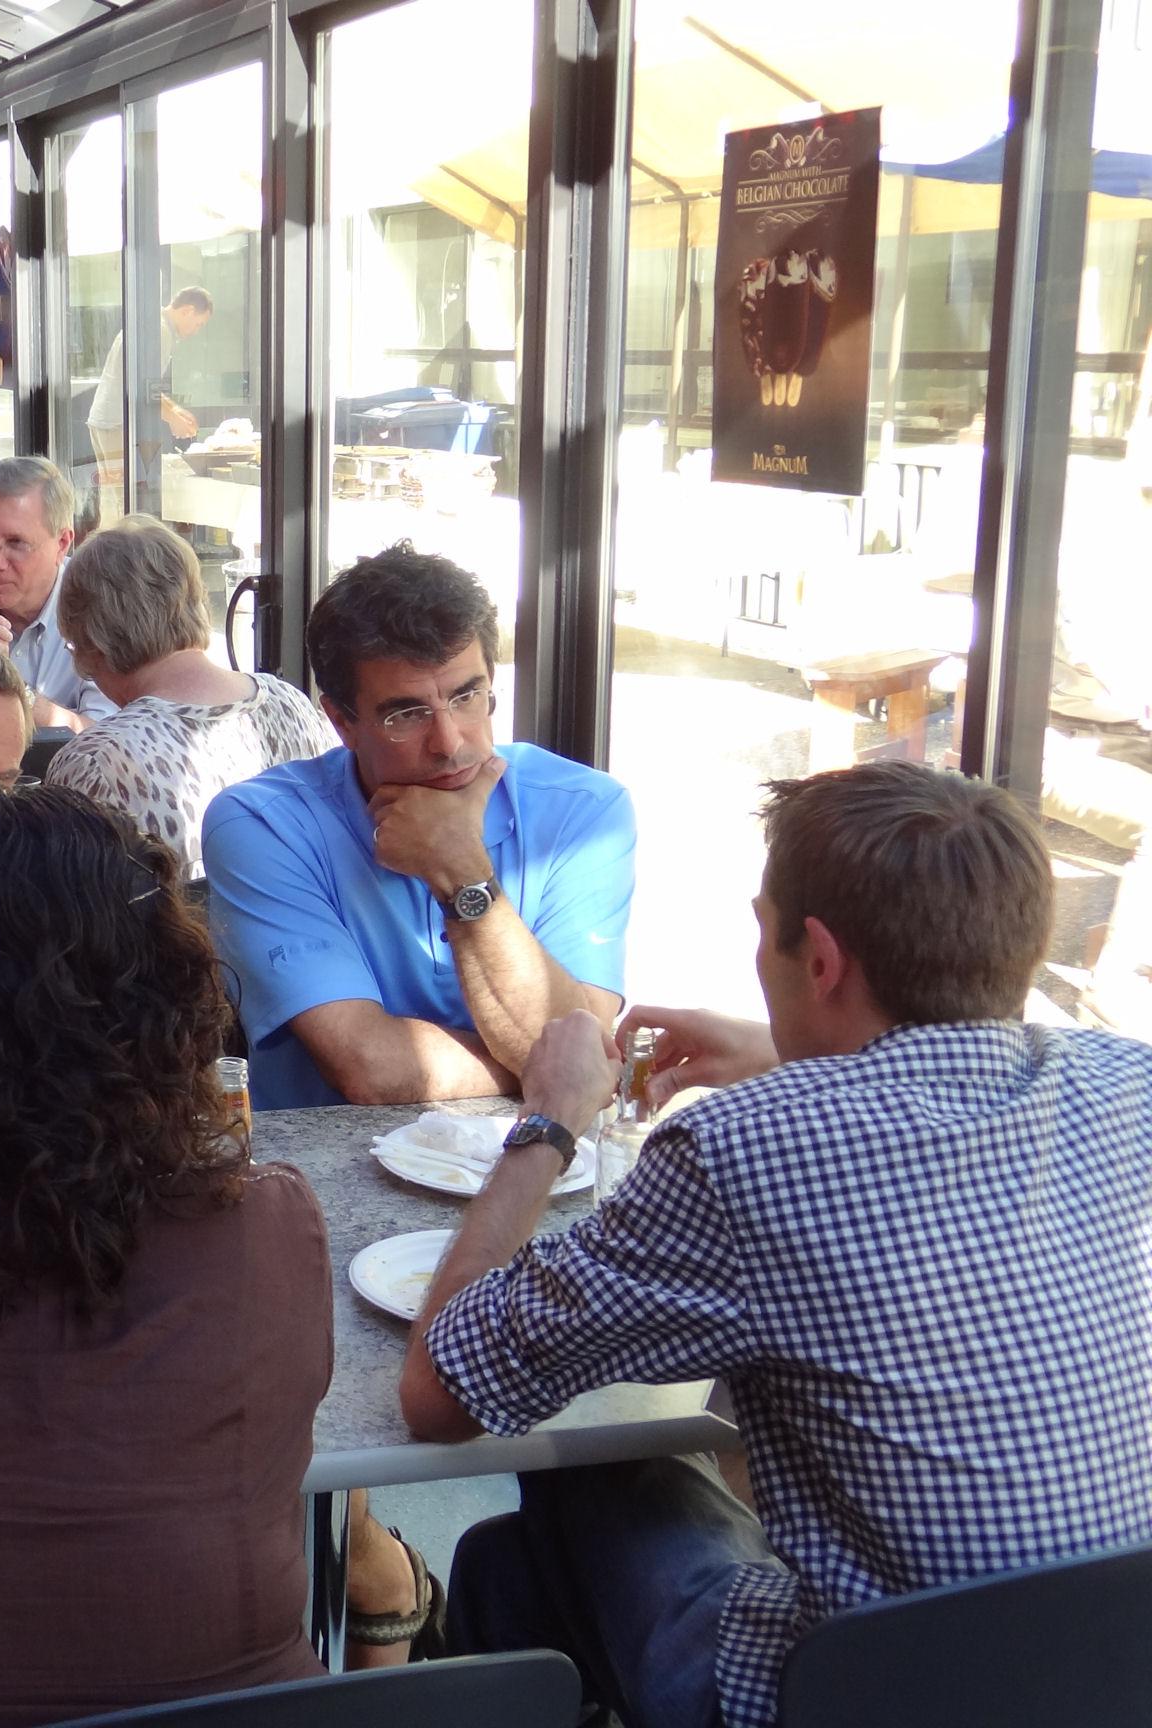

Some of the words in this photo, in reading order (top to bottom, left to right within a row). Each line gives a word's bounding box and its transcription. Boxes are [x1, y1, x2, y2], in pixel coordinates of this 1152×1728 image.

[769, 168, 800, 181] MAGNUM
[802, 164, 822, 177] WITH
[737, 184, 783, 204] BELGIAN
[784, 175, 849, 199] CHOCOLATE
[752, 452, 808, 475] MAGNUM
